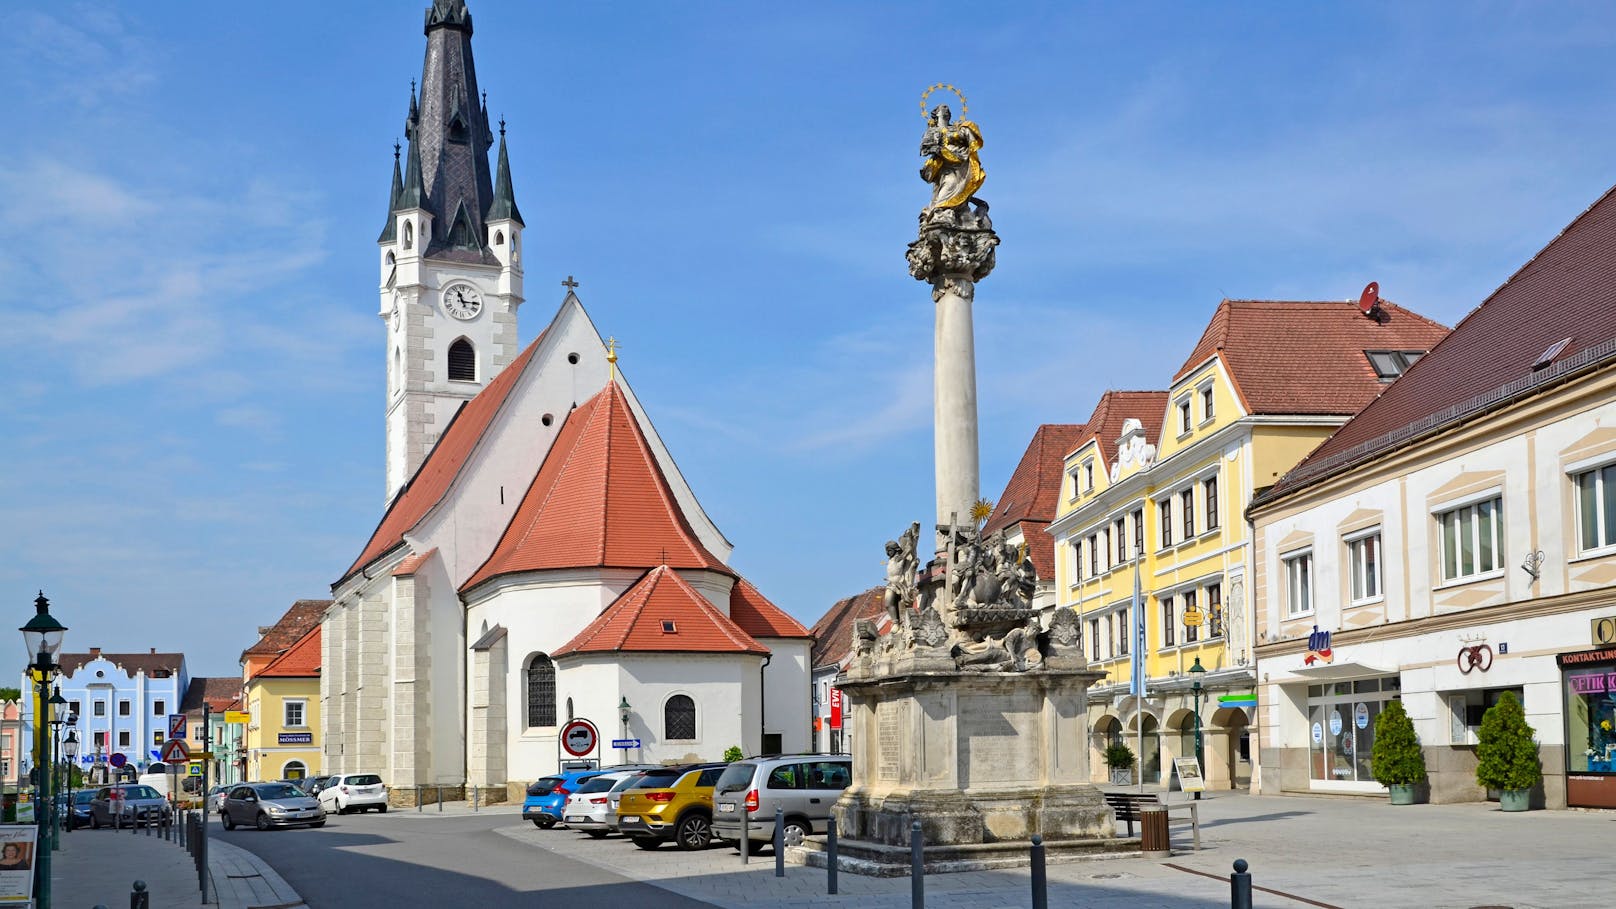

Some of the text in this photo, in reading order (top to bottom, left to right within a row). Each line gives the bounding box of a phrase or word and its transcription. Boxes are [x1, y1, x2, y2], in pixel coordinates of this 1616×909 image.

[1308, 625, 1331, 651] dm
[1597, 618, 1616, 645] O
[1570, 676, 1605, 692] OPTIK
[832, 689, 840, 708] EVN
